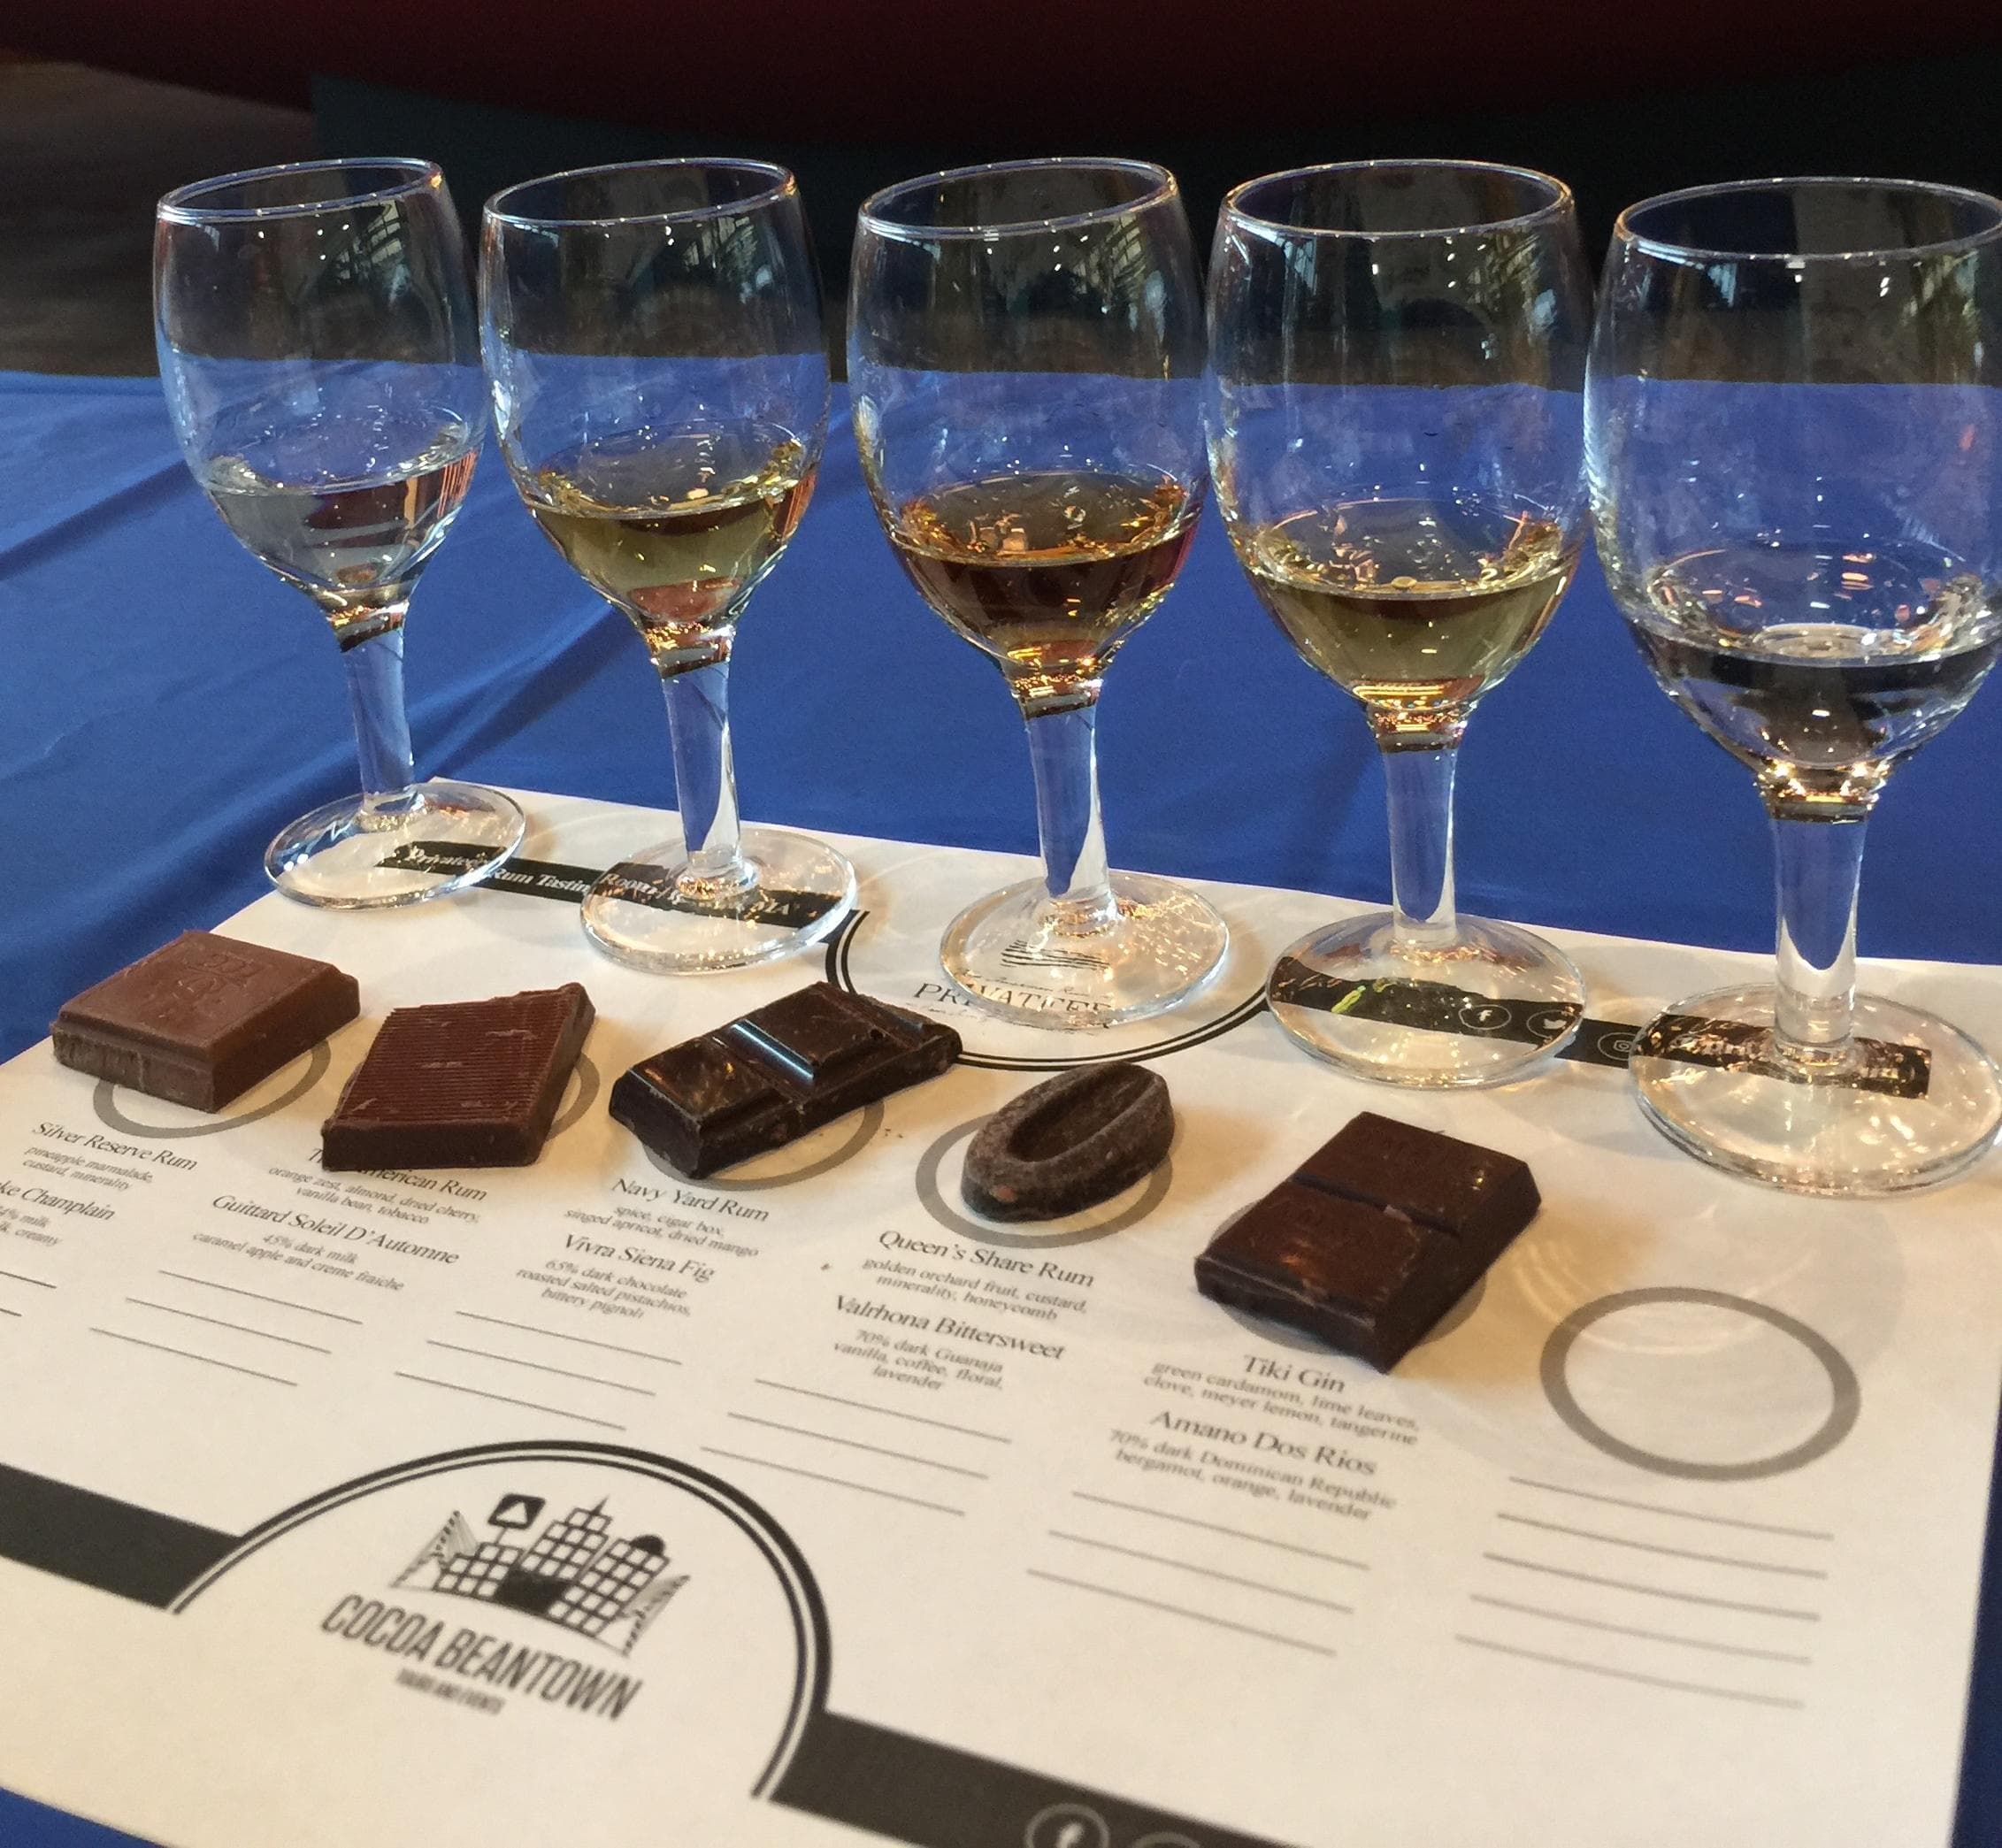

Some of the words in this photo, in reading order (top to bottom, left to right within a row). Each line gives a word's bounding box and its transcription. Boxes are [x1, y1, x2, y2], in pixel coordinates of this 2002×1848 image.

[493, 868, 533, 885] Rum
[538, 873, 591, 893] Tastin
[25, 1147, 86, 1167] pineapple
[32, 1122, 86, 1144] Silver
[83, 1134, 153, 1159] Reserve
[153, 1150, 197, 1171] Rum
[71, 1169, 131, 1192] minerality
[269, 1166, 313, 1184] orange
[313, 1177, 341, 1192] zest,
[344, 1185, 396, 1204] almond,
[400, 1194, 438, 1213] dried
[358, 1169, 438, 1190] merican
[440, 1179, 487, 1200] Rum
[610, 1177, 664, 1202] Navy
[672, 1189, 718, 1211] Yard
[718, 1200, 769, 1222] Rum
[21, 1187, 115, 1221] Champlain
[296, 1186, 340, 1204] vanilla
[341, 1195, 374, 1213] bean,
[378, 1205, 429, 1224] tobacco
[614, 1205, 654, 1222] spice,
[656, 1214, 693, 1231] cigar
[697, 1221, 725, 1237] box,
[193, 1233, 245, 1252] caramel
[245, 1245, 282, 1262] apple
[285, 1251, 312, 1267] and
[213, 1194, 292, 1223] Guittard
[288, 1213, 345, 1238] Soleil
[345, 1226, 459, 1264] D'Automne
[263, 1235, 292, 1250] 45%
[295, 1242, 324, 1257] dark
[326, 1249, 358, 1264] milk
[564, 1208, 610, 1226] singed
[613, 1218, 663, 1238] apricot,
[667, 1228, 709, 1246] dried
[710, 1239, 759, 1258] mango
[545, 1259, 579, 1274] 65%
[582, 1267, 614, 1283] dark
[617, 1275, 687, 1299] chocolate
[564, 1233, 616, 1258] Vivra
[618, 1246, 674, 1272] Siena
[679, 1259, 717, 1283] Fig
[878, 1230, 965, 1261] Queen's
[970, 1247, 1034, 1273] Share
[1039, 1261, 1095, 1287] Rum
[516, 1268, 571, 1287] roasted
[573, 1279, 614, 1298] salted
[863, 1257, 916, 1277] golden
[919, 1269, 981, 1290] orchard
[984, 1281, 1019, 1299] fruit,
[1025, 1291, 1087, 1314] custard,
[875, 1274, 957, 1301] minerality,
[963, 1290, 1059, 1322] honeycomb
[591, 1300, 645, 1319] pignoli
[835, 1294, 931, 1330] Valrhona
[935, 1317, 1066, 1361] Bittersweet
[833, 1340, 889, 1362] vanilla,
[895, 1354, 948, 1376] coffee,
[955, 1368, 1003, 1391] floral,
[855, 1330, 890, 1346] 70%
[894, 1339, 928, 1356] dark
[872, 1366, 943, 1391] lavender
[1151, 1361, 1202, 1382] green
[1207, 1373, 1305, 1406] cardamom,
[1311, 1394, 1353, 1415] lime
[1358, 1405, 1420, 1431] leaves,
[1242, 1353, 1292, 1382] Tiki
[1298, 1369, 1346, 1393] Gin
[1144, 1376, 1195, 1398] clove,
[1200, 1390, 1258, 1410] meyer
[1262, 1400, 1323, 1426] lemon,
[1331, 1415, 1418, 1446] tangerine
[1149, 1410, 1247, 1445] Amano
[1253, 1431, 1307, 1458] Dos
[1314, 1445, 1377, 1476] Rios
[1109, 1429, 1149, 1450] 70%
[1154, 1441, 1193, 1461] dark
[1200, 1450, 1304, 1486] Dominican
[1308, 1476, 1397, 1510] Republic
[1114, 1447, 1206, 1481] bergamot,
[1212, 1470, 1280, 1499] orange,
[1287, 1488, 1372, 1521] lavender
[320, 1593, 445, 1662] COCOA
[433, 1628, 644, 1721] BEANTOWN
